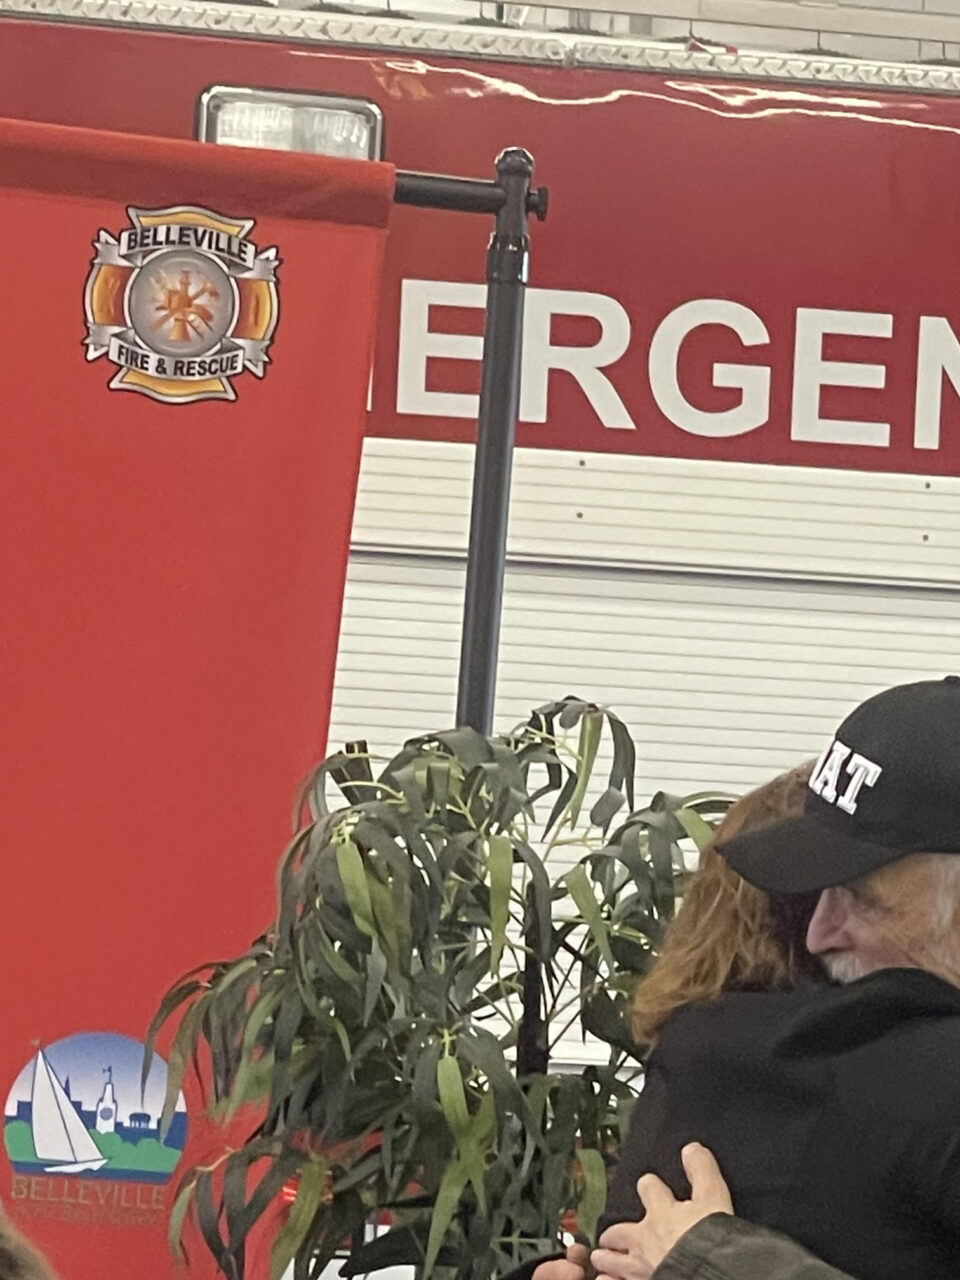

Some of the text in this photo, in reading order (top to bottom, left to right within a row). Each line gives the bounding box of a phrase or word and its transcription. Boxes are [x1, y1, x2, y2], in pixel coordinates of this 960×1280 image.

[126, 226, 249, 263] BELLEVILLE
[116, 344, 240, 377] FIRE & RESCUE
[11, 1175, 166, 1211] BELLEVILLE
